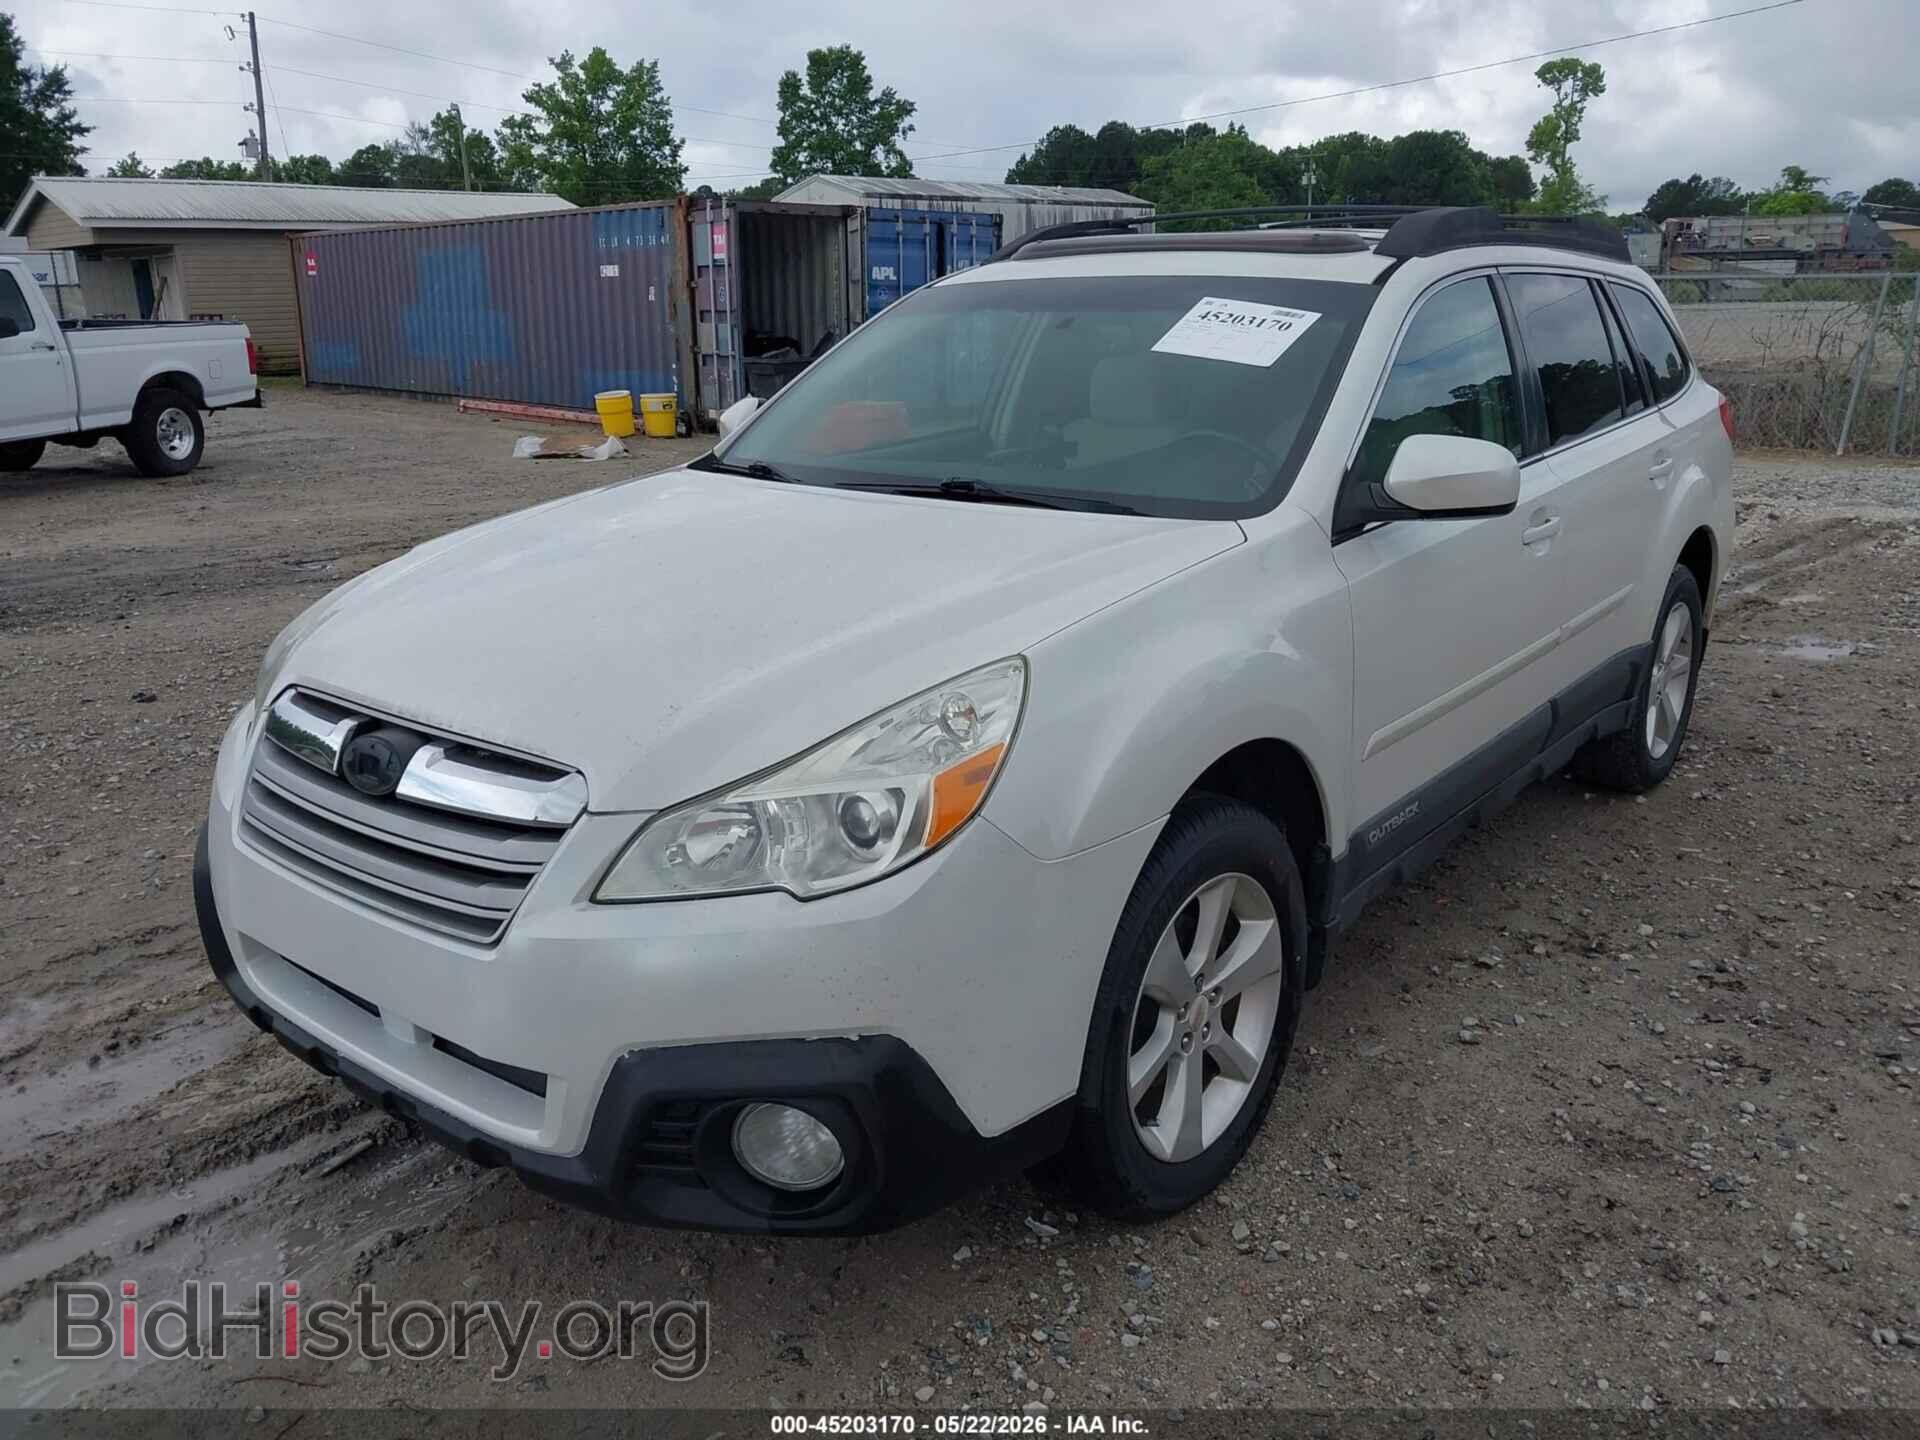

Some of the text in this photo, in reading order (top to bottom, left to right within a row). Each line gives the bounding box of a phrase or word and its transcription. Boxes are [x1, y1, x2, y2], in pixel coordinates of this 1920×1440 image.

[872, 266, 897, 280] APL
[1198, 310, 1292, 331] 45203170
[1369, 801, 1421, 842] OUTBACK
